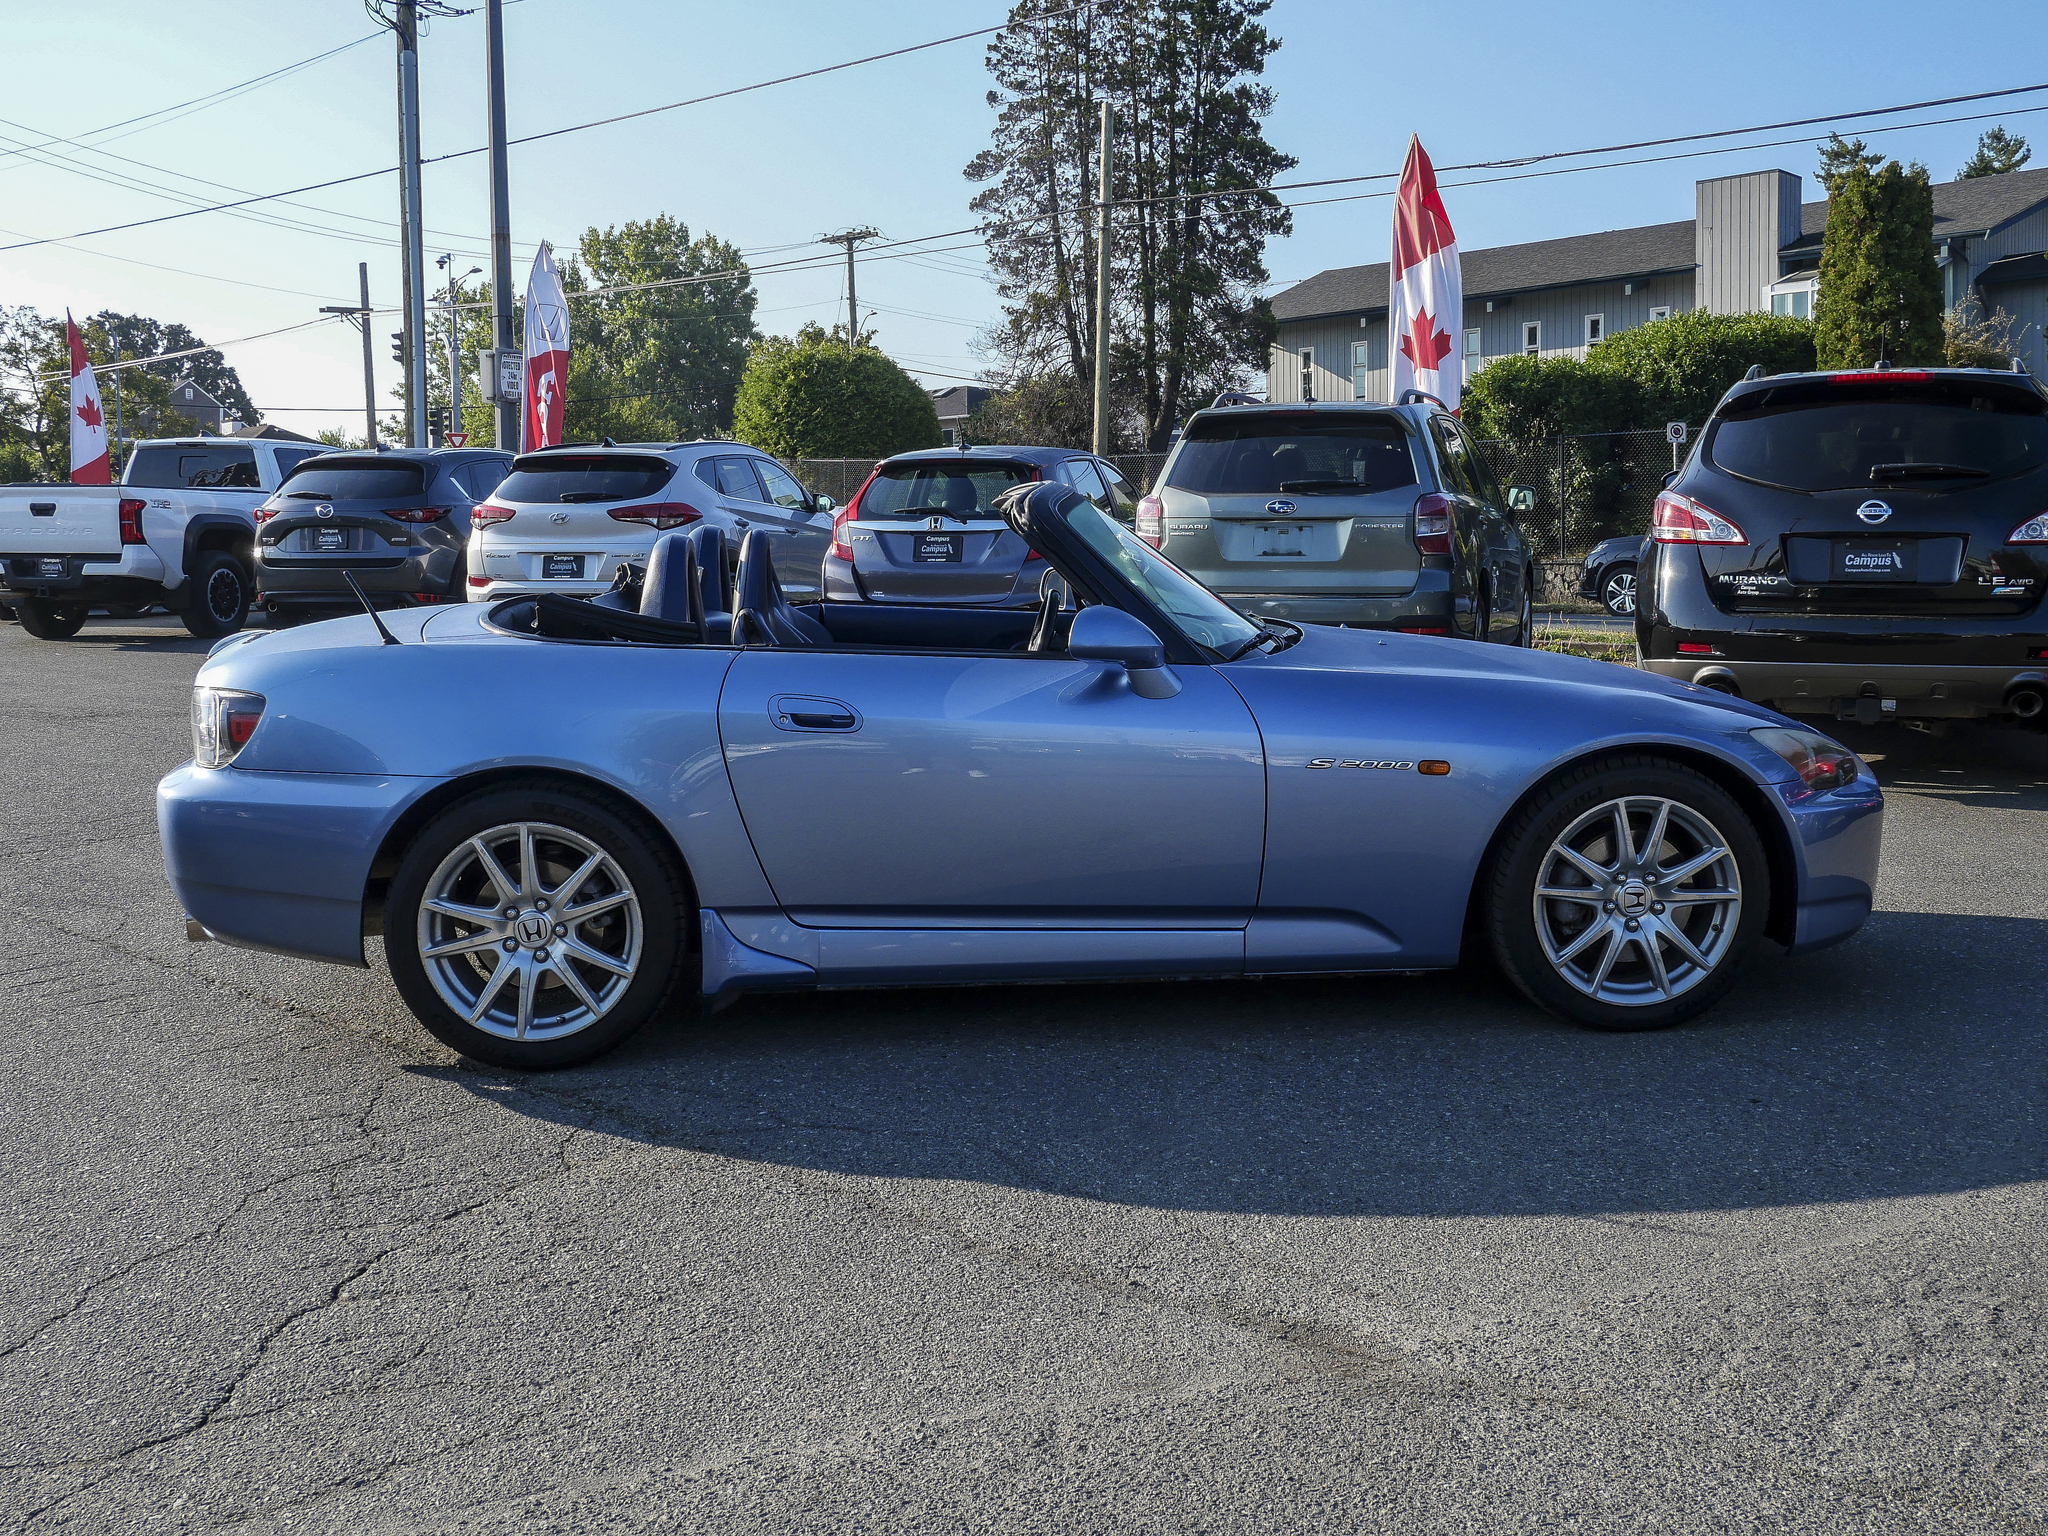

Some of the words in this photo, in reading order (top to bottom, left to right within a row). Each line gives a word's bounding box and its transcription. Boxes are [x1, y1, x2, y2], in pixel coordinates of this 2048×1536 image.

[0, 528, 96, 536] TACOMA
[921, 545, 948, 554] Campus
[1845, 554, 1892, 567] Campus
[550, 563, 572, 571] Campus
[1719, 575, 1778, 585] MURANO
[1978, 576, 2006, 586] LE
